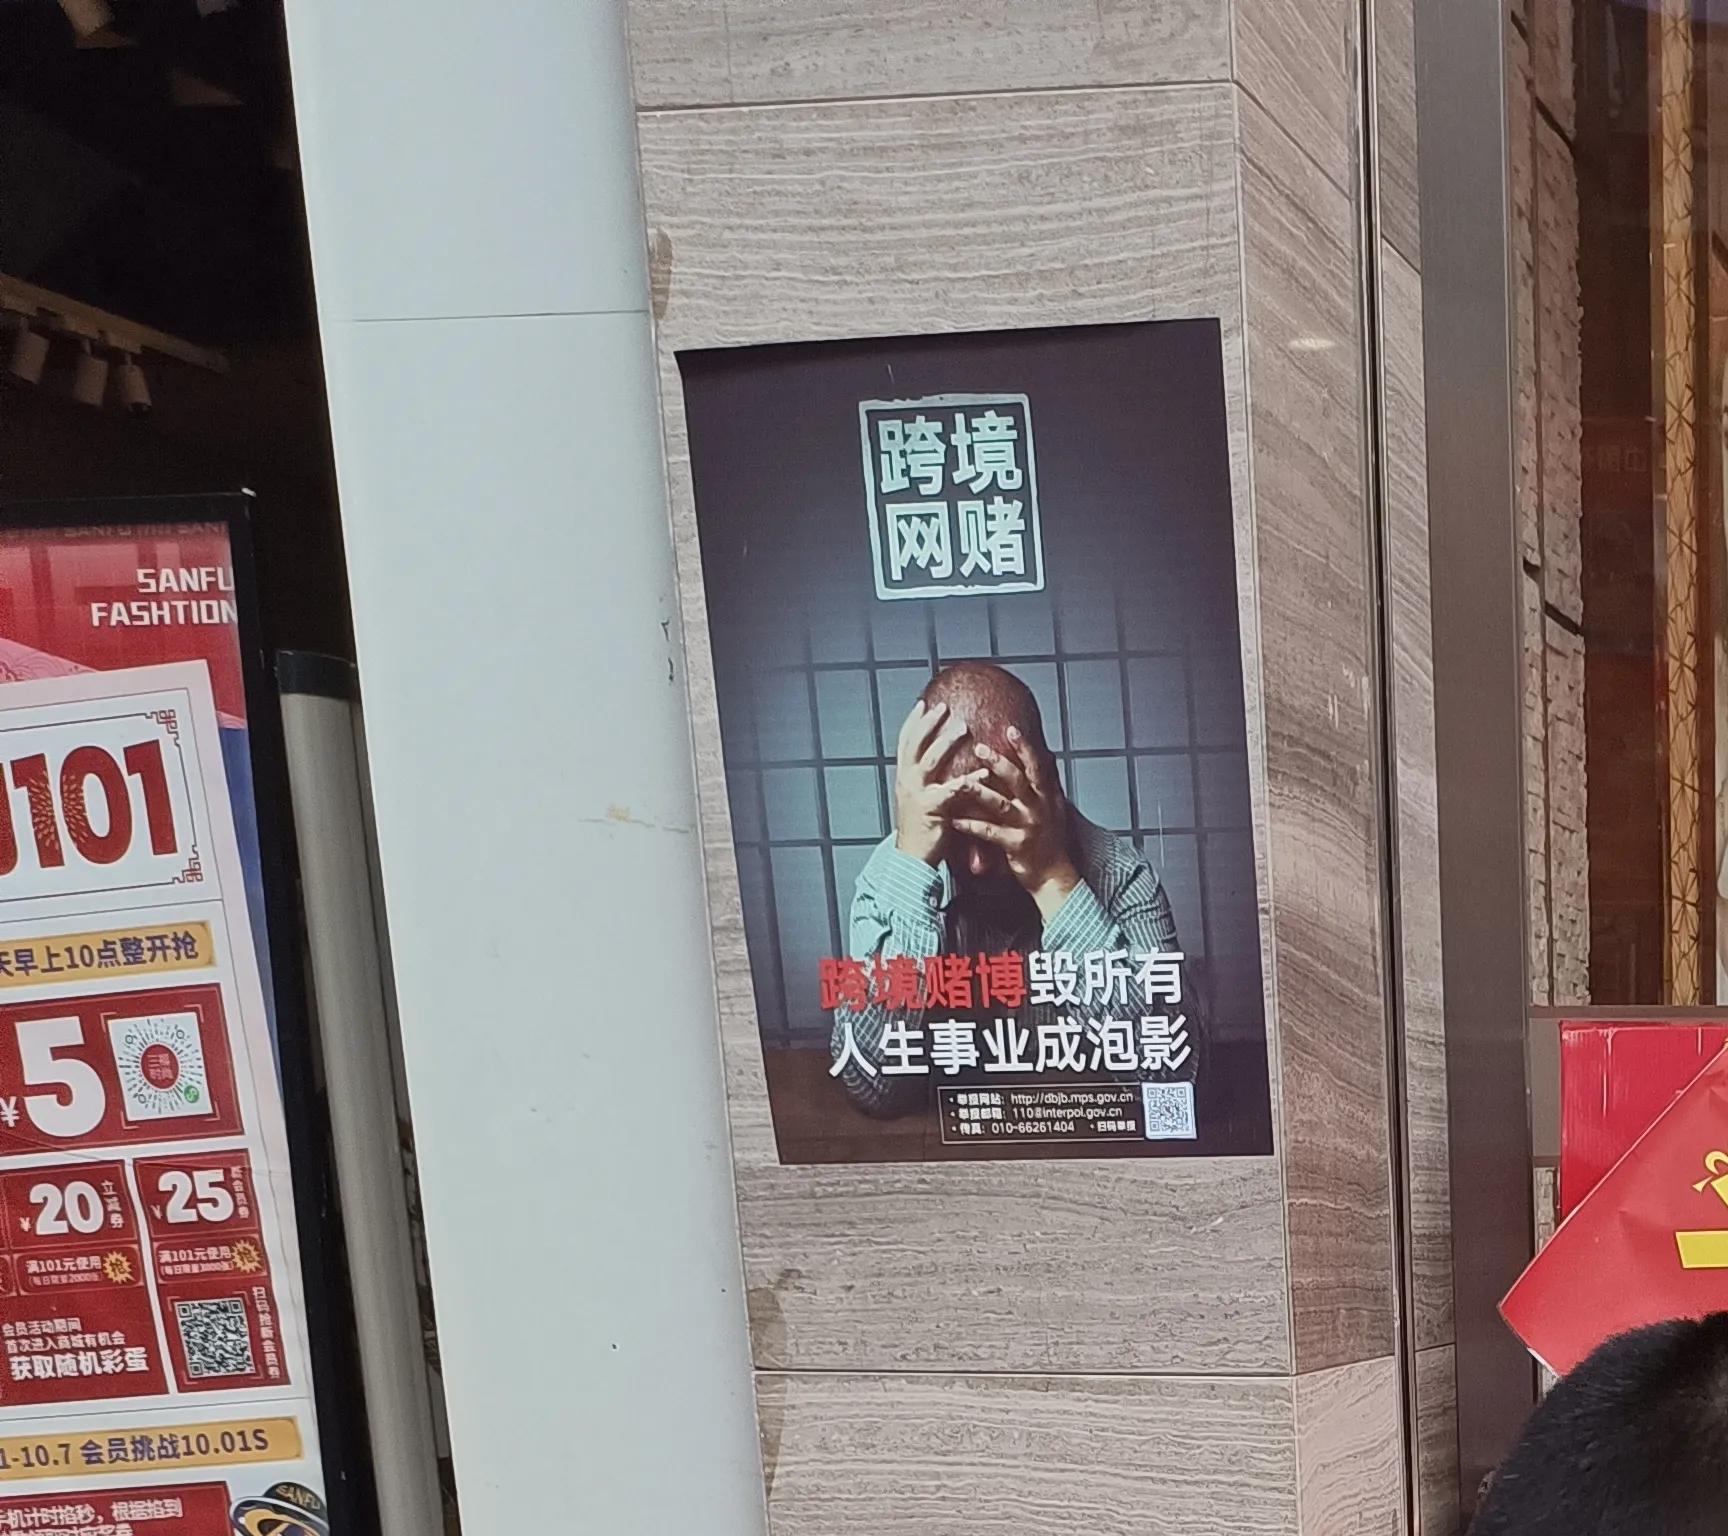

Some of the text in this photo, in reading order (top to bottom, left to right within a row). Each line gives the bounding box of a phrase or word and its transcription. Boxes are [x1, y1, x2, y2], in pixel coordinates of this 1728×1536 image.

[878, 409, 1023, 495] 跨境
[885, 496, 1026, 581] 网赌
[136, 566, 236, 593] SANFU
[91, 600, 238, 627] FASHTION
[0, 739, 178, 876] 101
[818, 948, 1184, 1012] 跨境赌博毁所有
[828, 1014, 1192, 1079] 人生事业成泡影
[991, 1121, 1075, 1134] 010-66261404
[9, 1346, 149, 1382] 获取随机彩蛋
